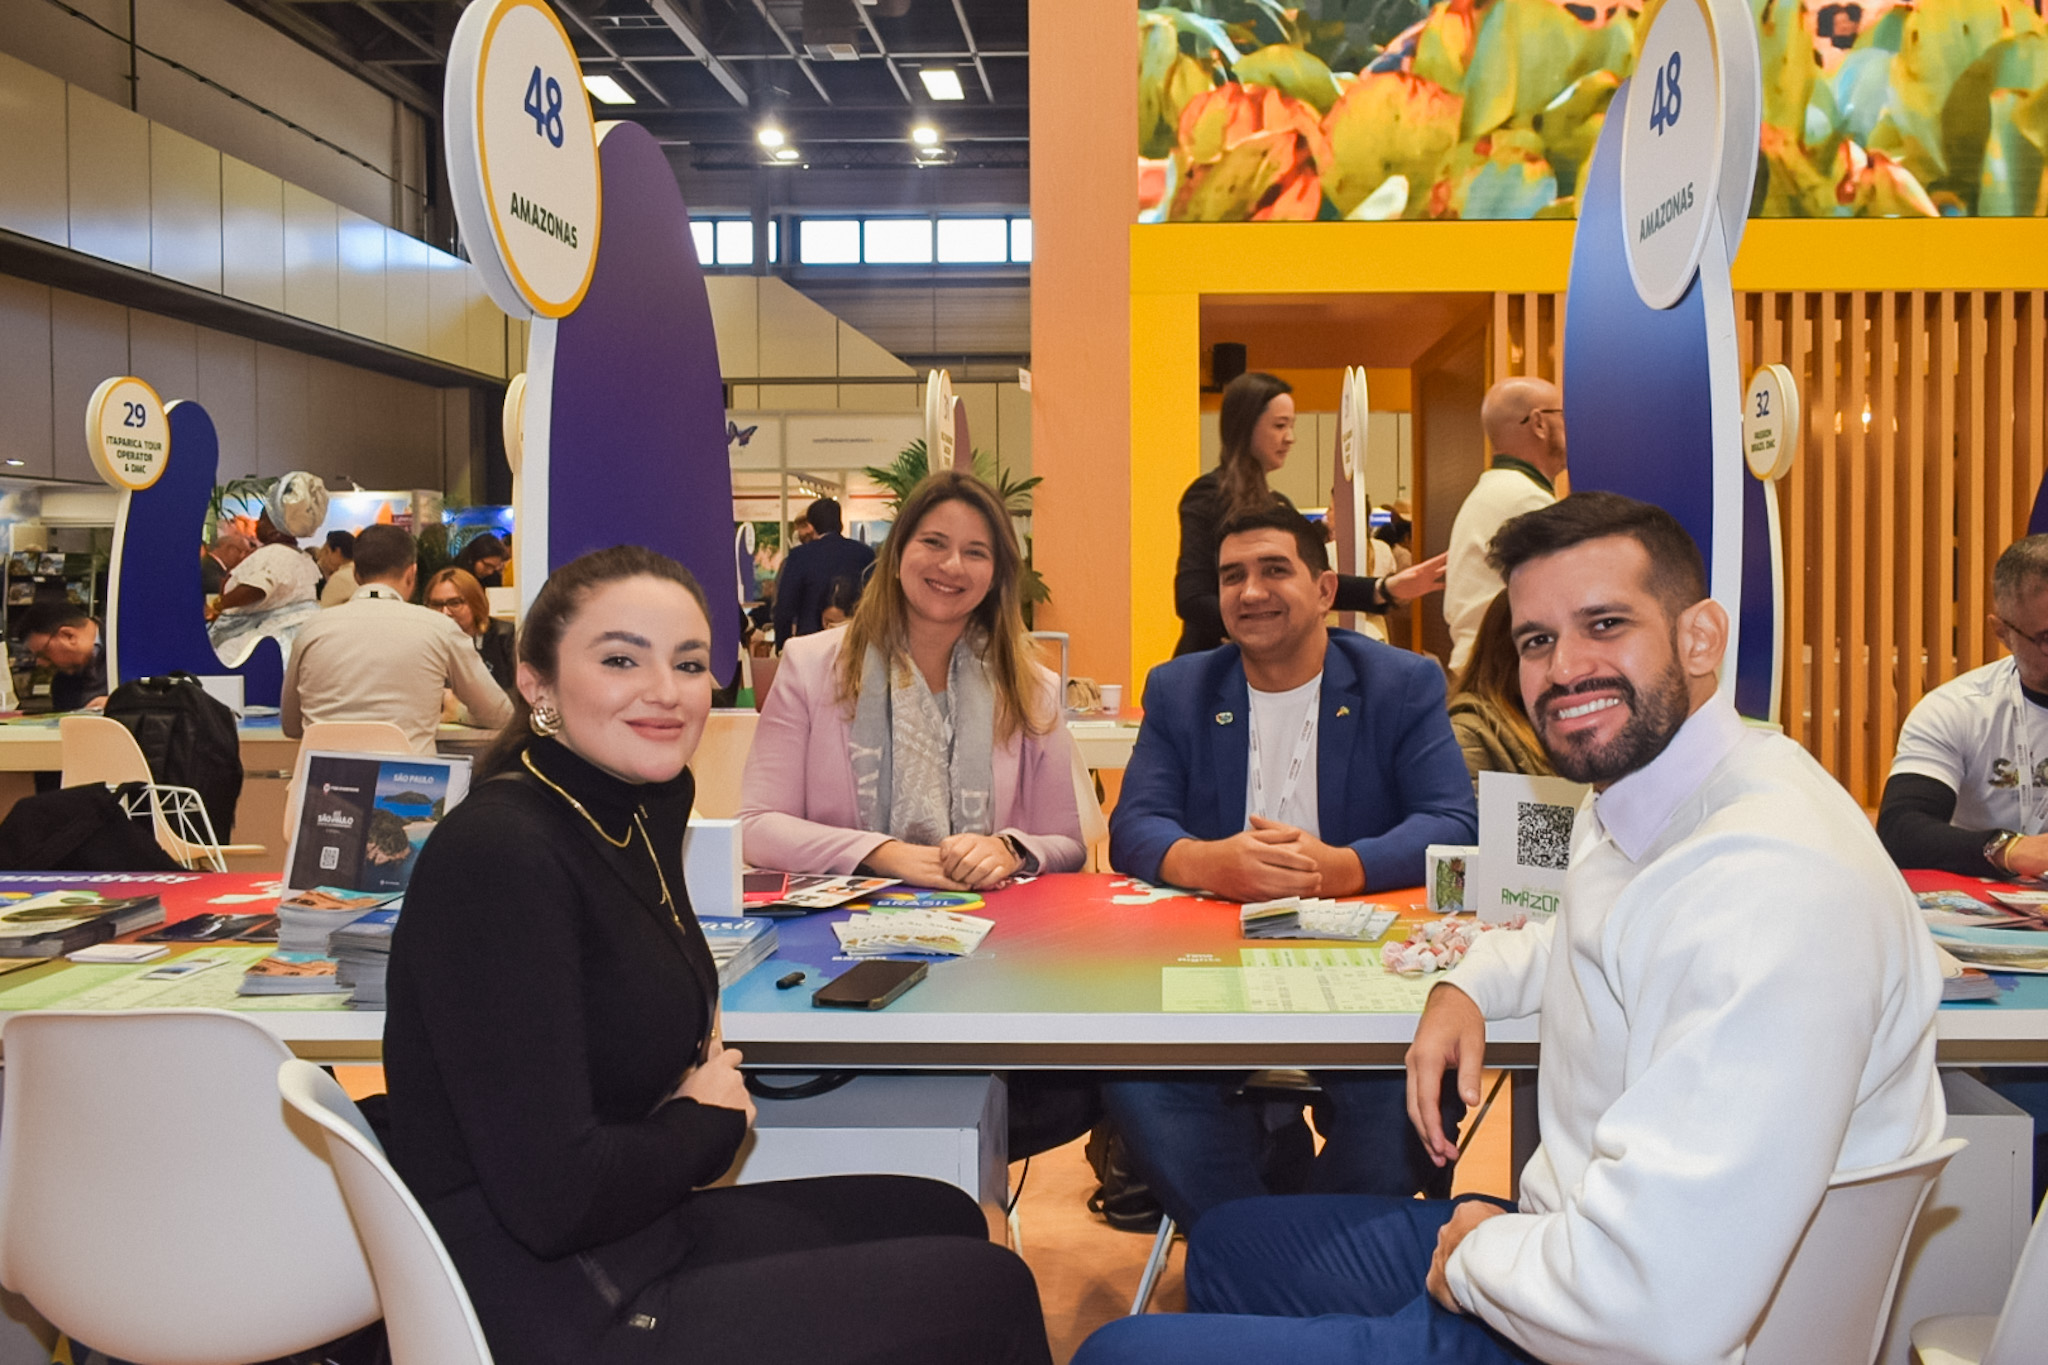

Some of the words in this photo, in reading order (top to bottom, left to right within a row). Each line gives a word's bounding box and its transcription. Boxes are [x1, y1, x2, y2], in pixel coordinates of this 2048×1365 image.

[524, 65, 564, 148] 48
[1650, 51, 1682, 137] 48
[511, 192, 578, 249] AMAZONAS
[1640, 182, 1694, 243] AMAZONAS
[123, 401, 146, 428] 29
[1755, 389, 1770, 418] 32
[106, 435, 142, 448] ITAPARICA
[144, 440, 162, 451] TOUR
[116, 449, 153, 462] OPERATOR
[393, 772, 409, 783] SÃO
[409, 775, 435, 784] PAULO
